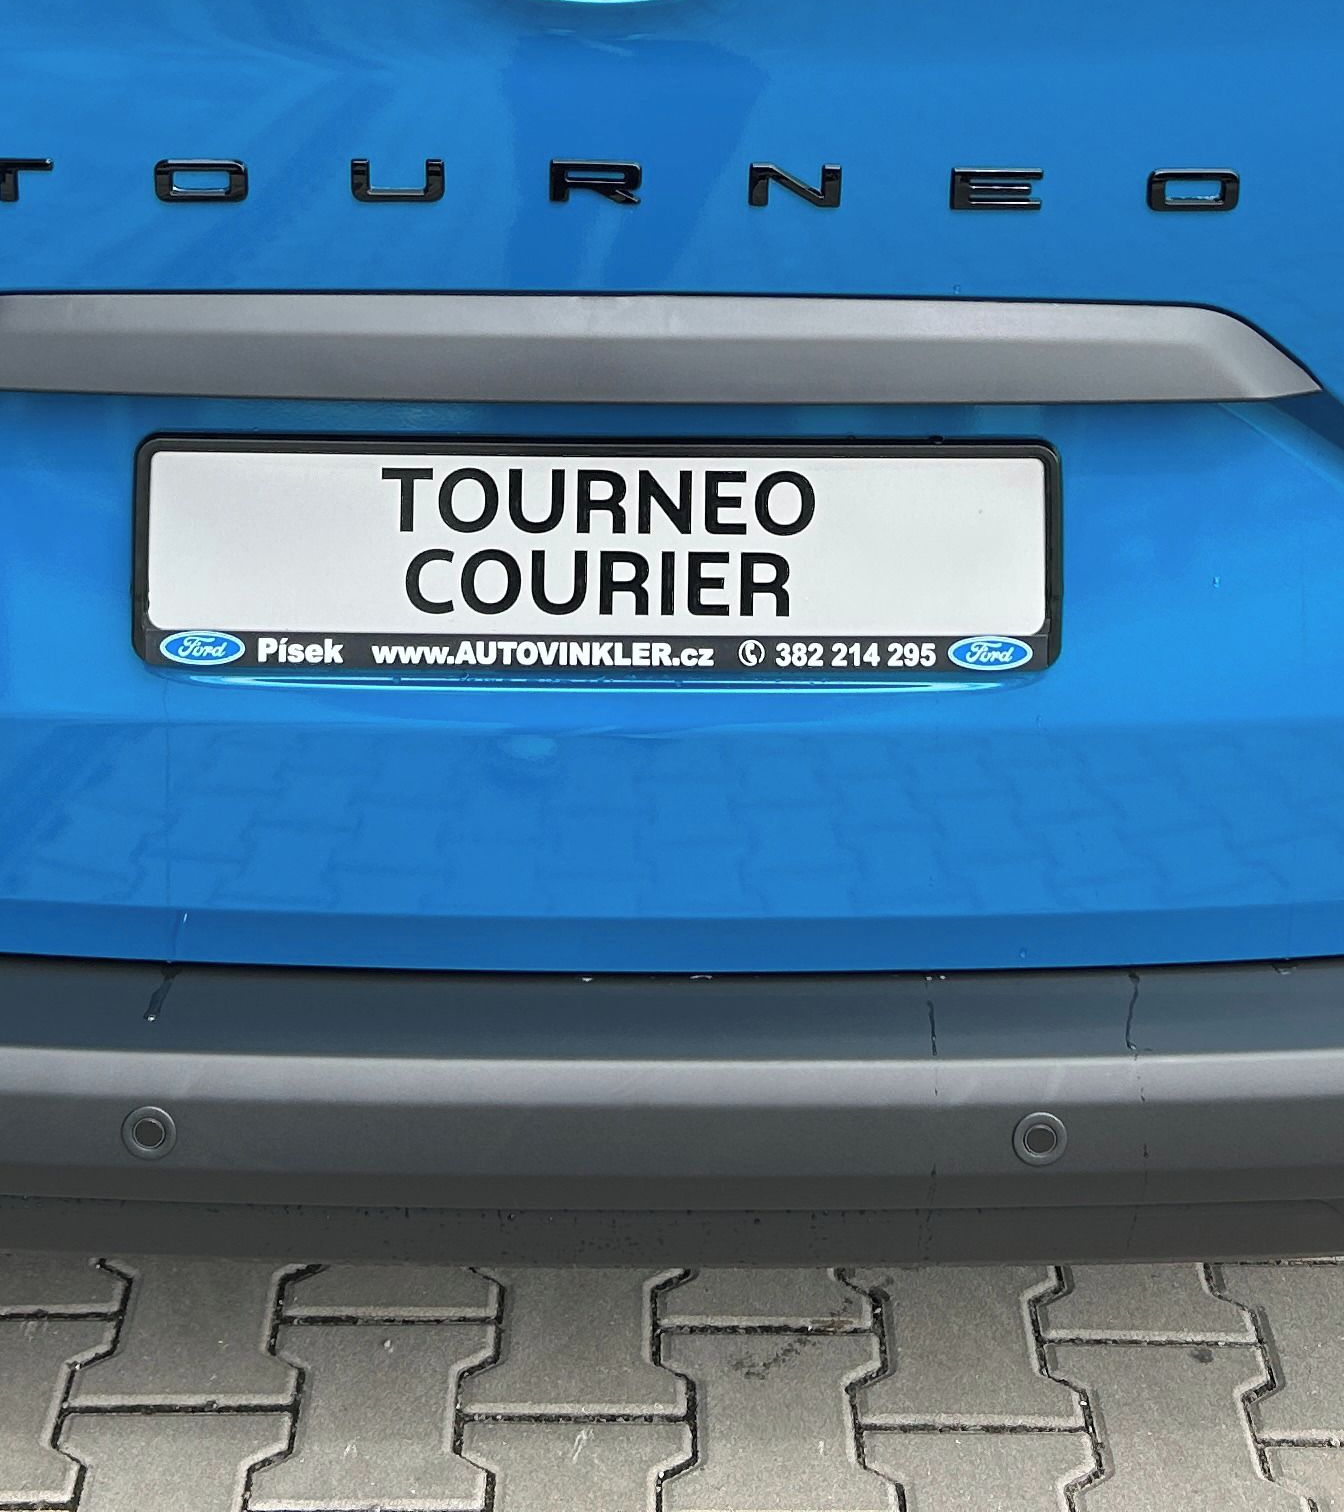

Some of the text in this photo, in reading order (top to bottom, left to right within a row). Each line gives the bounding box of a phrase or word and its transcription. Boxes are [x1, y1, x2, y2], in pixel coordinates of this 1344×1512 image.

[382, 468, 815, 536] TOURNEO
[406, 549, 789, 617] COURIER
[258, 638, 936, 666] Písek www.AUTOVINKLER.cz 382 214 295
